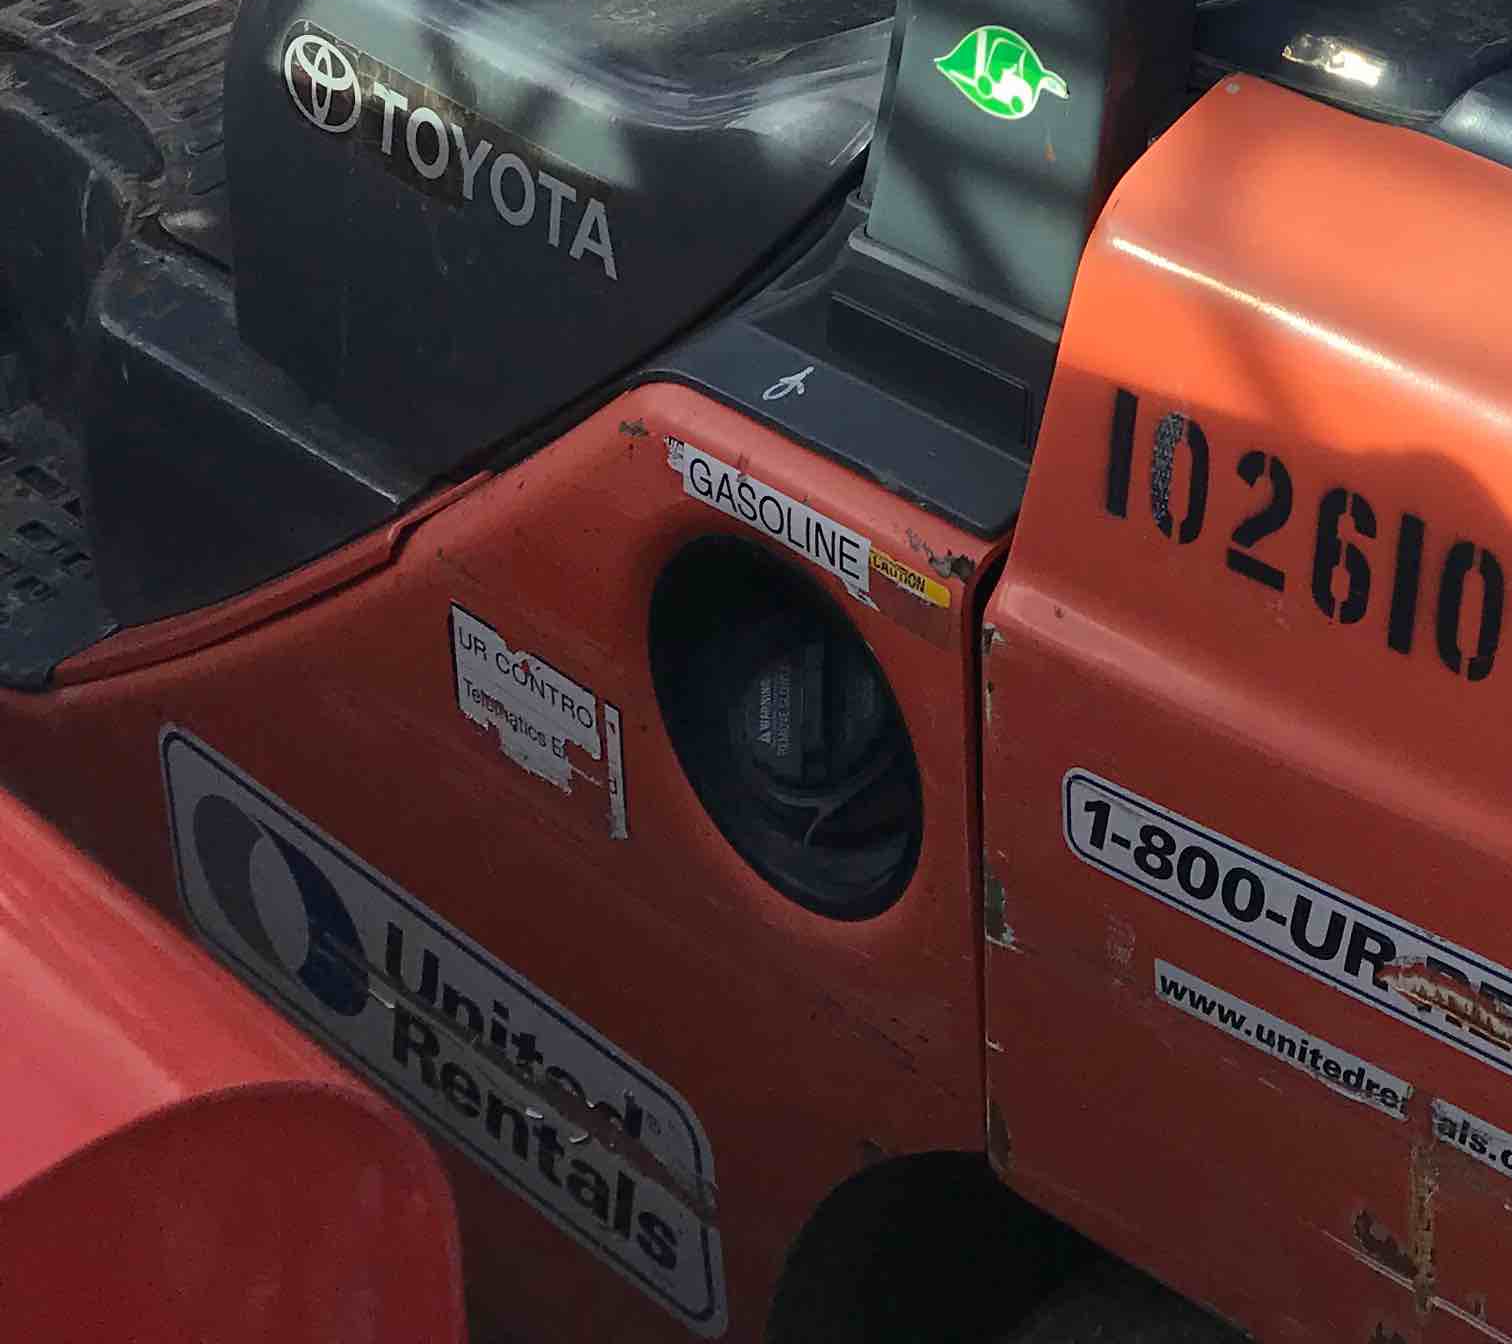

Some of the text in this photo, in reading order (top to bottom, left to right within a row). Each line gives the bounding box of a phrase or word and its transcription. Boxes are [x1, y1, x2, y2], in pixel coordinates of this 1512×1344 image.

[373, 81, 619, 282] TOYOTA
[688, 456, 863, 581] GASOLINE
[871, 552, 928, 594] CAUTION
[458, 625, 614, 736] UR CONTRO
[389, 1010, 679, 1272] Rentals
